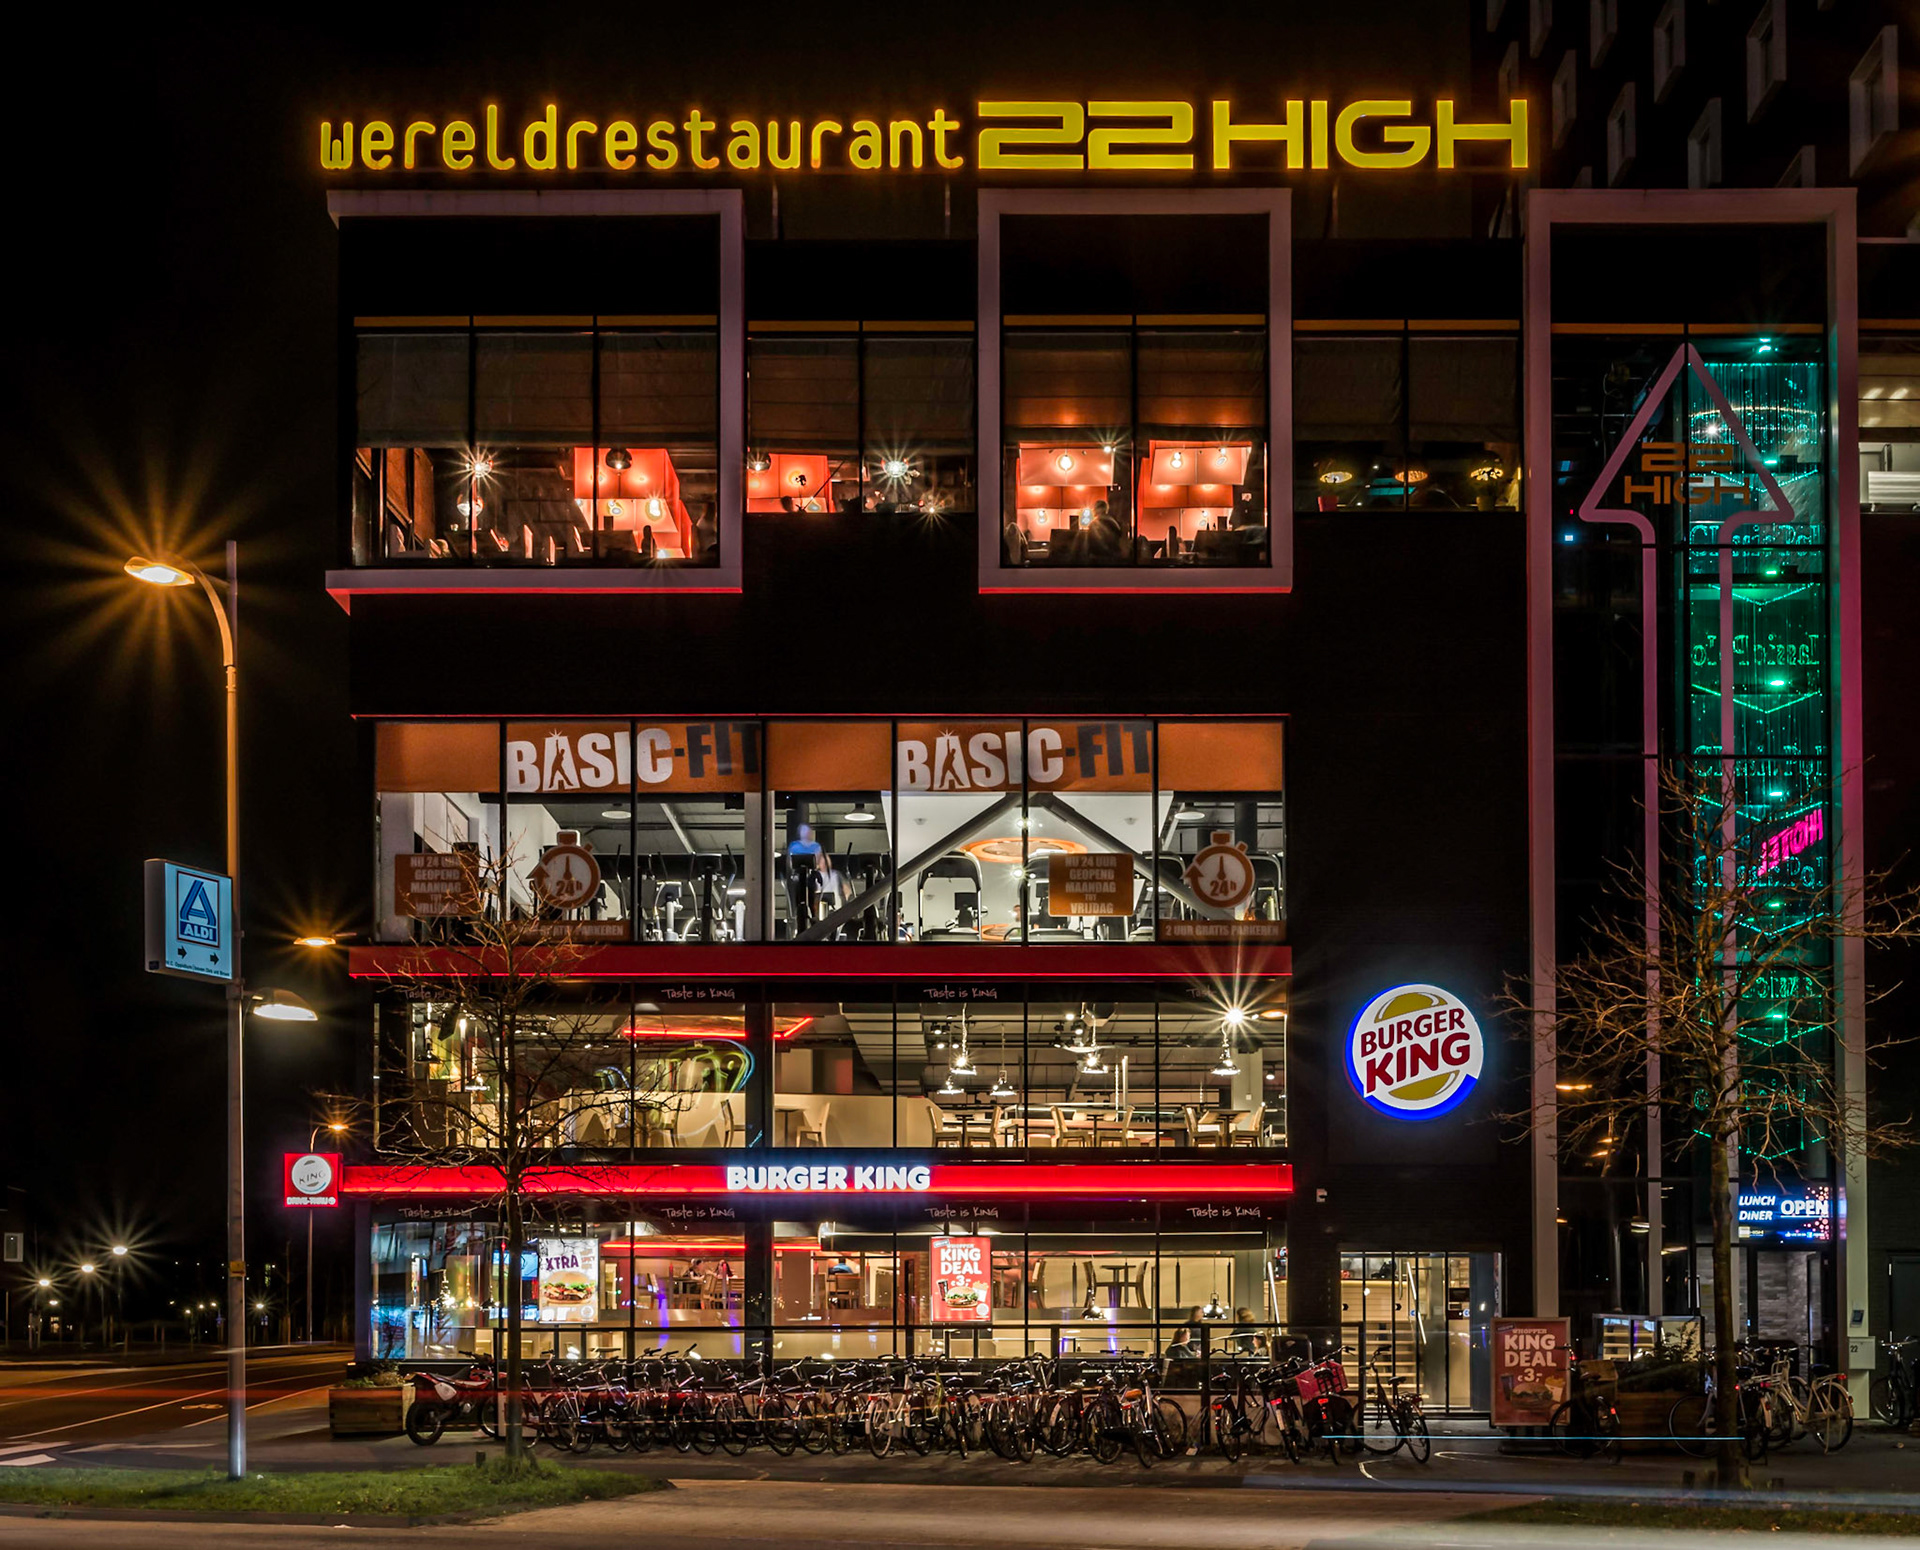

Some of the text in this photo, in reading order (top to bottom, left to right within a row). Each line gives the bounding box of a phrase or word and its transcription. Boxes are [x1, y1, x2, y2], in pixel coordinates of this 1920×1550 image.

[319, 99, 1529, 171] wereldrestaurant 22 HIGH
[1641, 442, 1734, 472] 22
[1624, 476, 1751, 505] HIGH
[507, 722, 761, 792] BASIC-FIT
[898, 722, 1153, 791] BASIC-FIT
[427, 856, 439, 867] 24
[1081, 856, 1093, 867] 24
[414, 869, 460, 881] GEOPEND
[1069, 869, 1115, 880] GEOPEND
[410, 881, 461, 893] MAANDAG
[1065, 881, 1117, 893] MAANDAG
[1070, 902, 1114, 914] VRIJDAG
[184, 924, 213, 940] ALDI
[1196, 925, 1230, 936] GRATIS
[1231, 925, 1280, 937] PARKEREN
[661, 985, 735, 999] Taste is KING
[923, 984, 998, 999] Taste is KING
[1361, 1008, 1466, 1058] BURGER
[1366, 1032, 1470, 1094] KING
[727, 1165, 931, 1190] BURGER KING
[1739, 1195, 1776, 1206] LUNCH
[1780, 1199, 1829, 1216] OPEN
[398, 1203, 430, 1218] Taste
[661, 1204, 735, 1219] Taste is KING
[924, 1204, 999, 1218] Taste is KING
[1186, 1203, 1261, 1218] Taste is KING
[1739, 1211, 1773, 1221] DINER
[940, 1248, 981, 1261] KING
[546, 1254, 579, 1271] XTRA
[940, 1262, 983, 1275] DEAL
[1504, 1334, 1556, 1351] KING
[1504, 1351, 1557, 1367] DEAL
